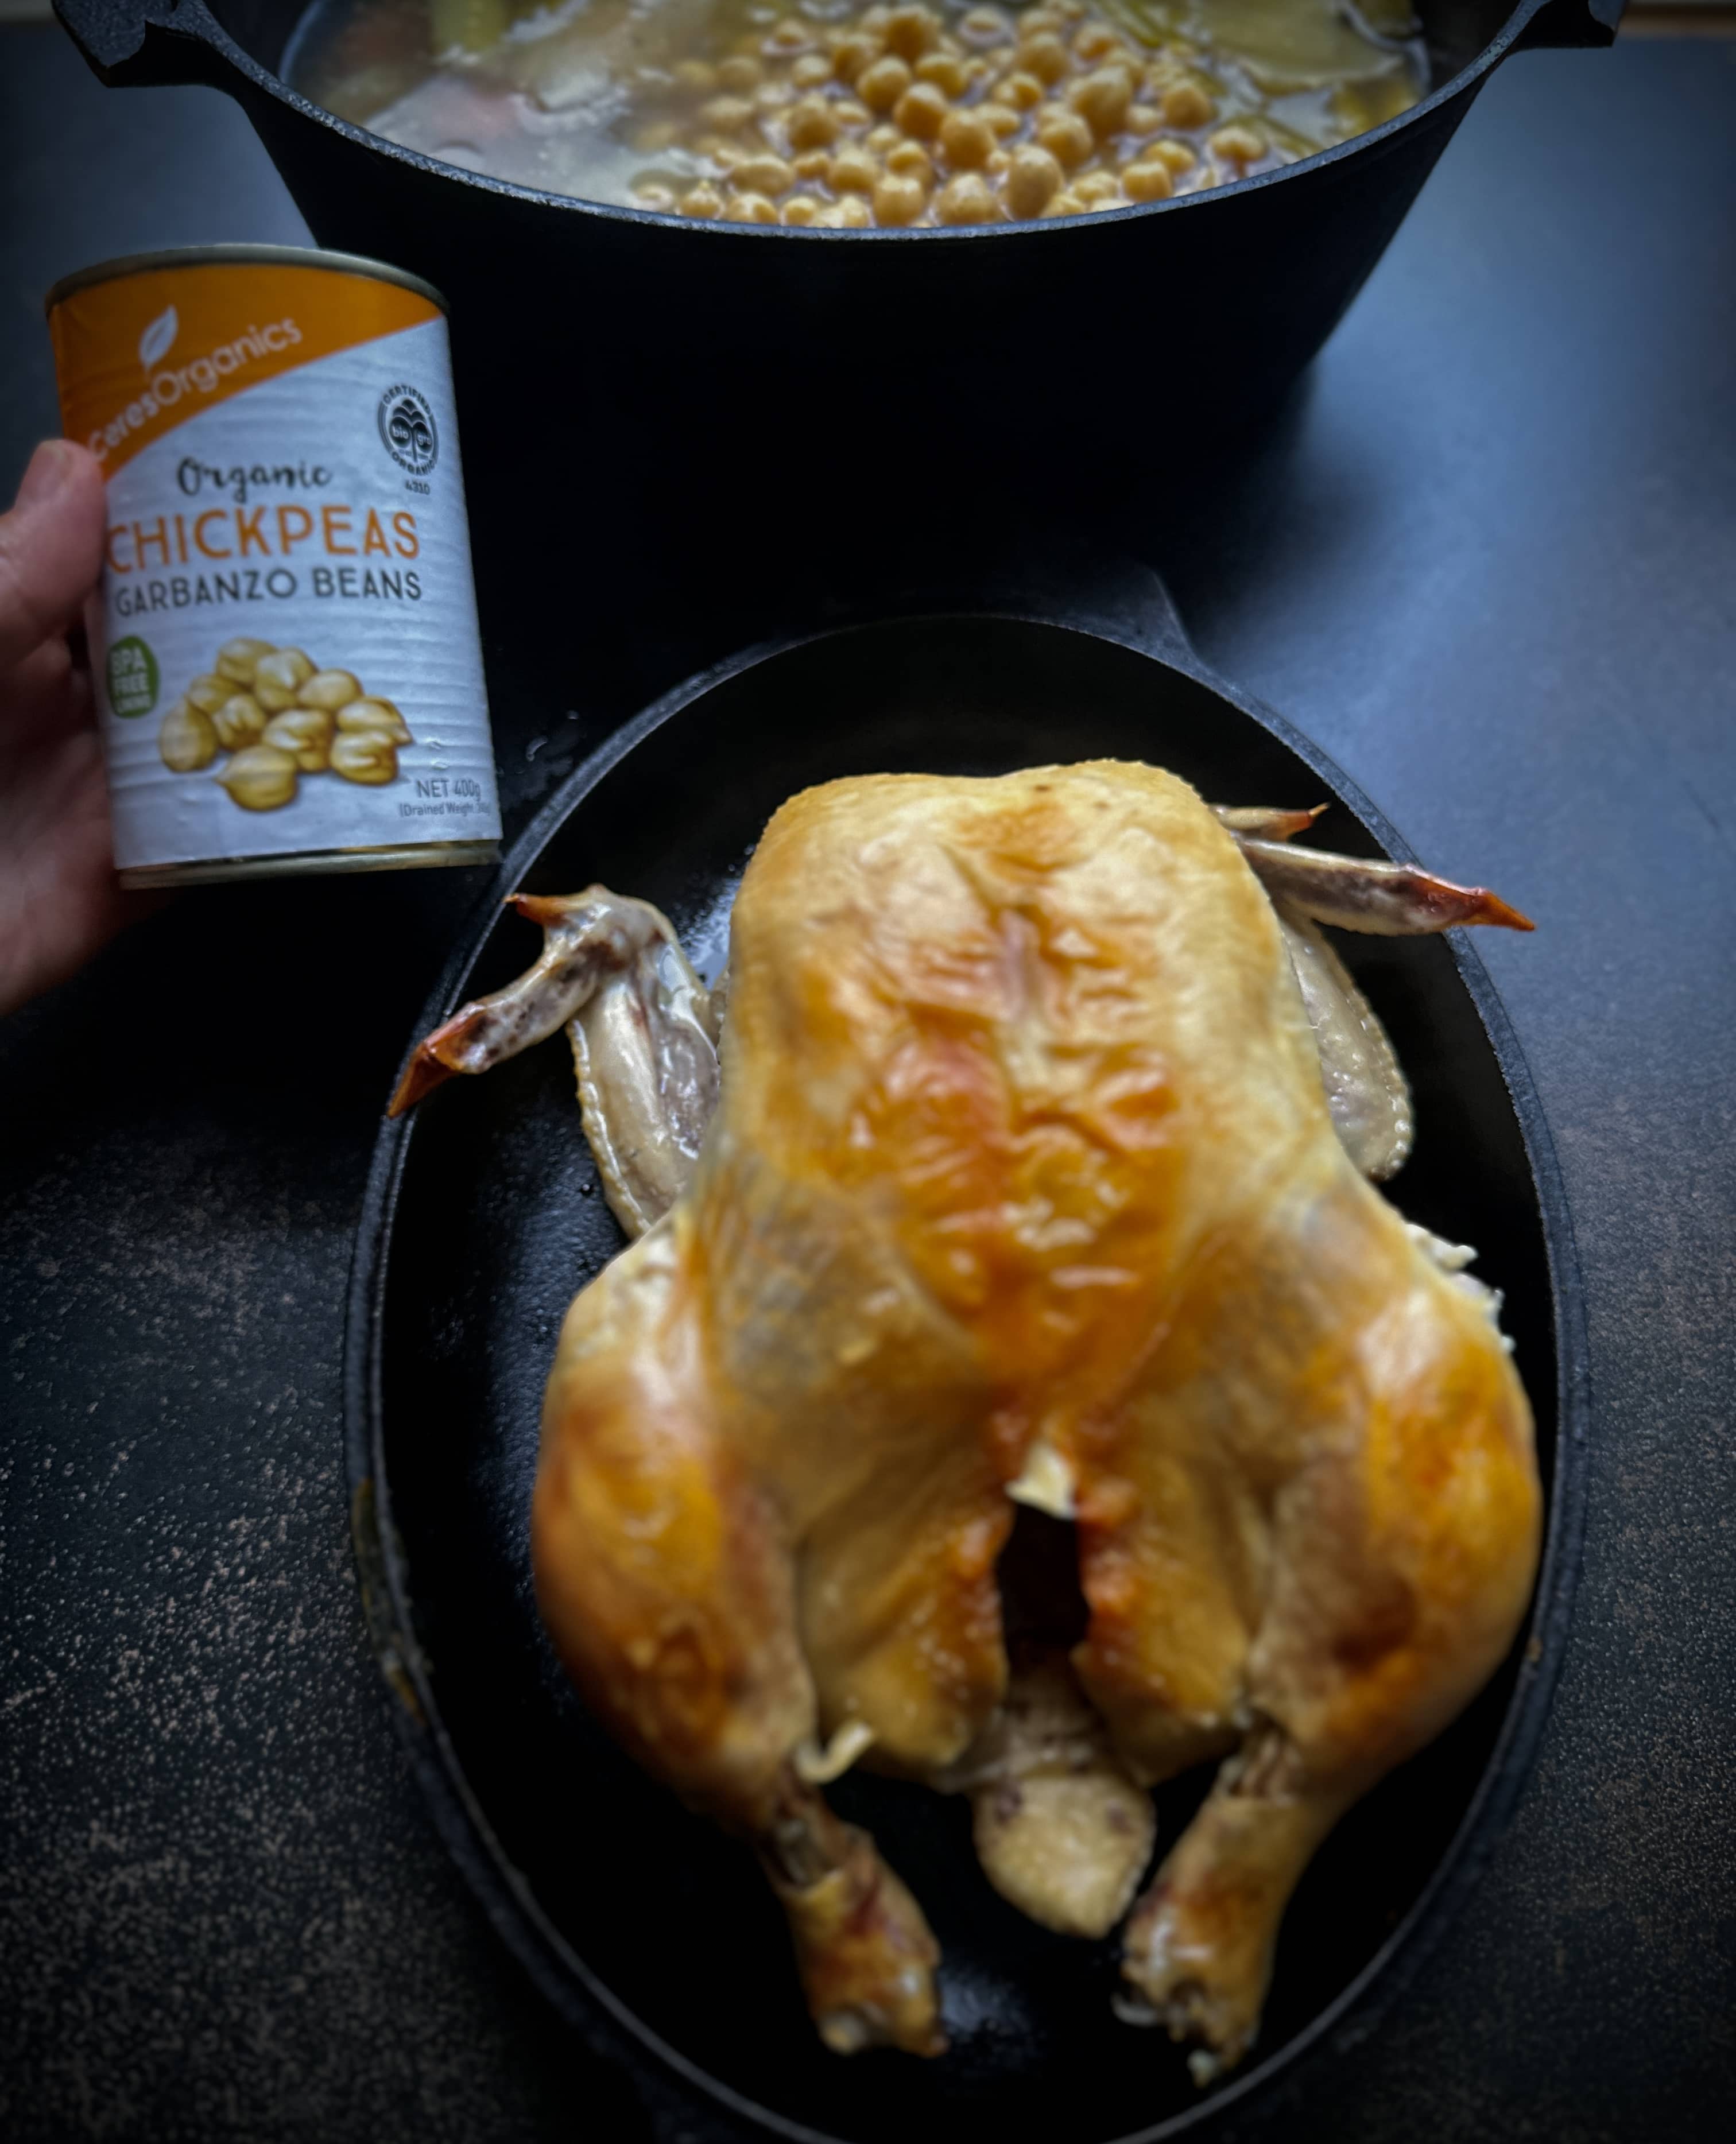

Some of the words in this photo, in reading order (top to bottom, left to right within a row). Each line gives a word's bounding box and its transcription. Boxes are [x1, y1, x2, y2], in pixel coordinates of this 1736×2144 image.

[177, 457, 332, 504] Organic
[106, 505, 421, 574] CHICKPEAS
[115, 568, 299, 618] GARBANZO
[312, 567, 423, 601] BEANS
[416, 778, 450, 798] NET
[454, 778, 482, 802] 400g
